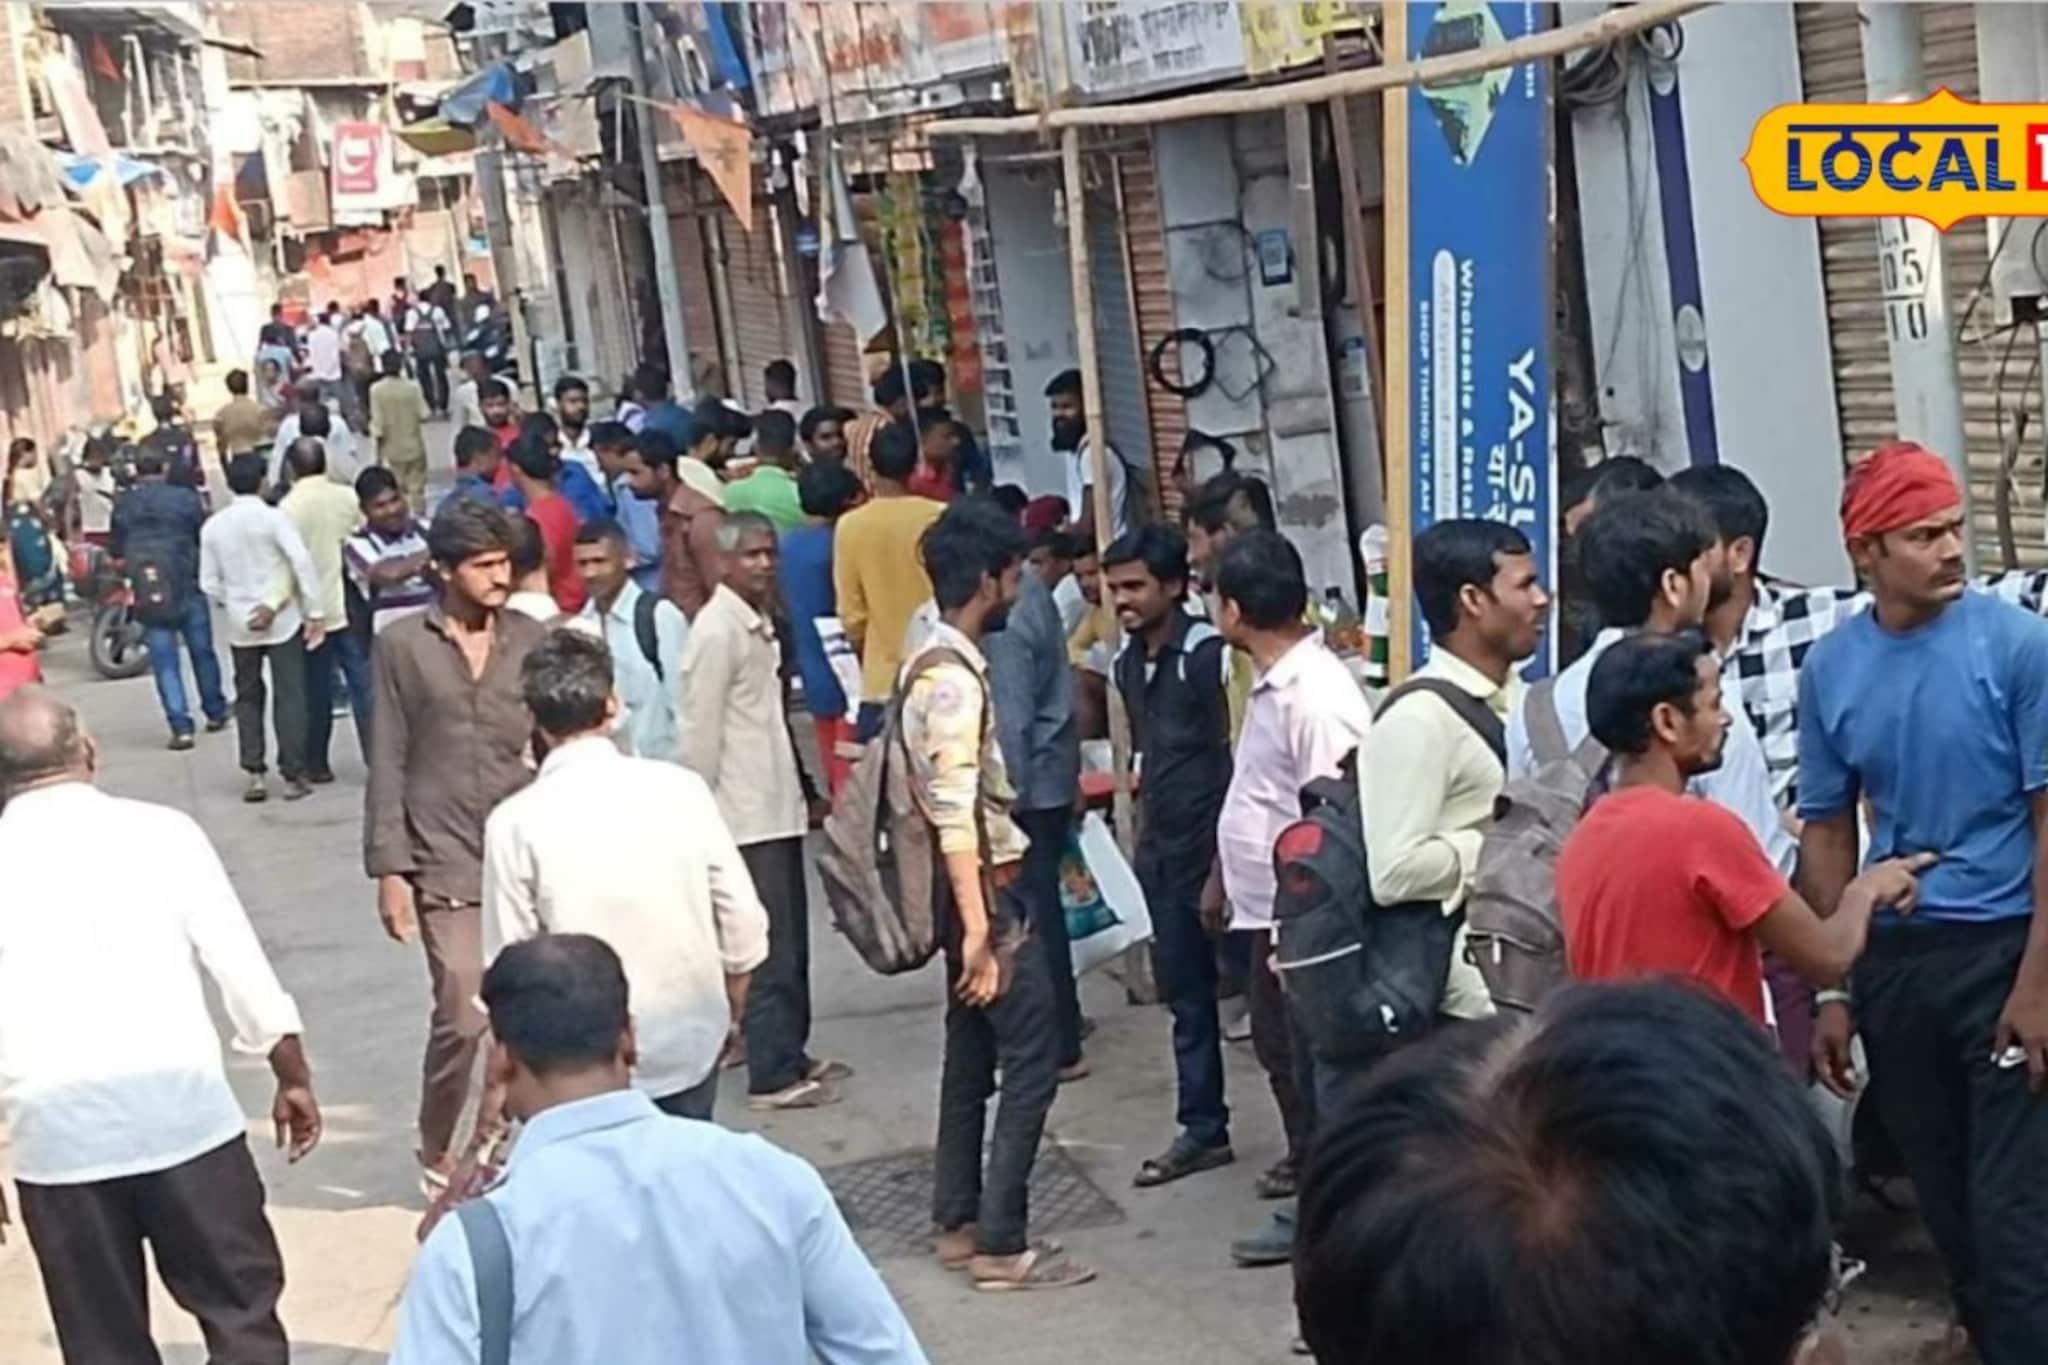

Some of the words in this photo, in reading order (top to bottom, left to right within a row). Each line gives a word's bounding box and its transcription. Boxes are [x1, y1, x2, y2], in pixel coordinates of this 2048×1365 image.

[1883, 249, 1924, 291] 05
[1419, 300, 1430, 359] SHOP
[1460, 259, 1474, 411] Wholesale
[1888, 301, 1927, 341] 10
[1419, 366, 1429, 446] TIMING:
[1461, 418, 1474, 436] &
[1419, 453, 1430, 474] 10
[1420, 480, 1430, 512] AM
